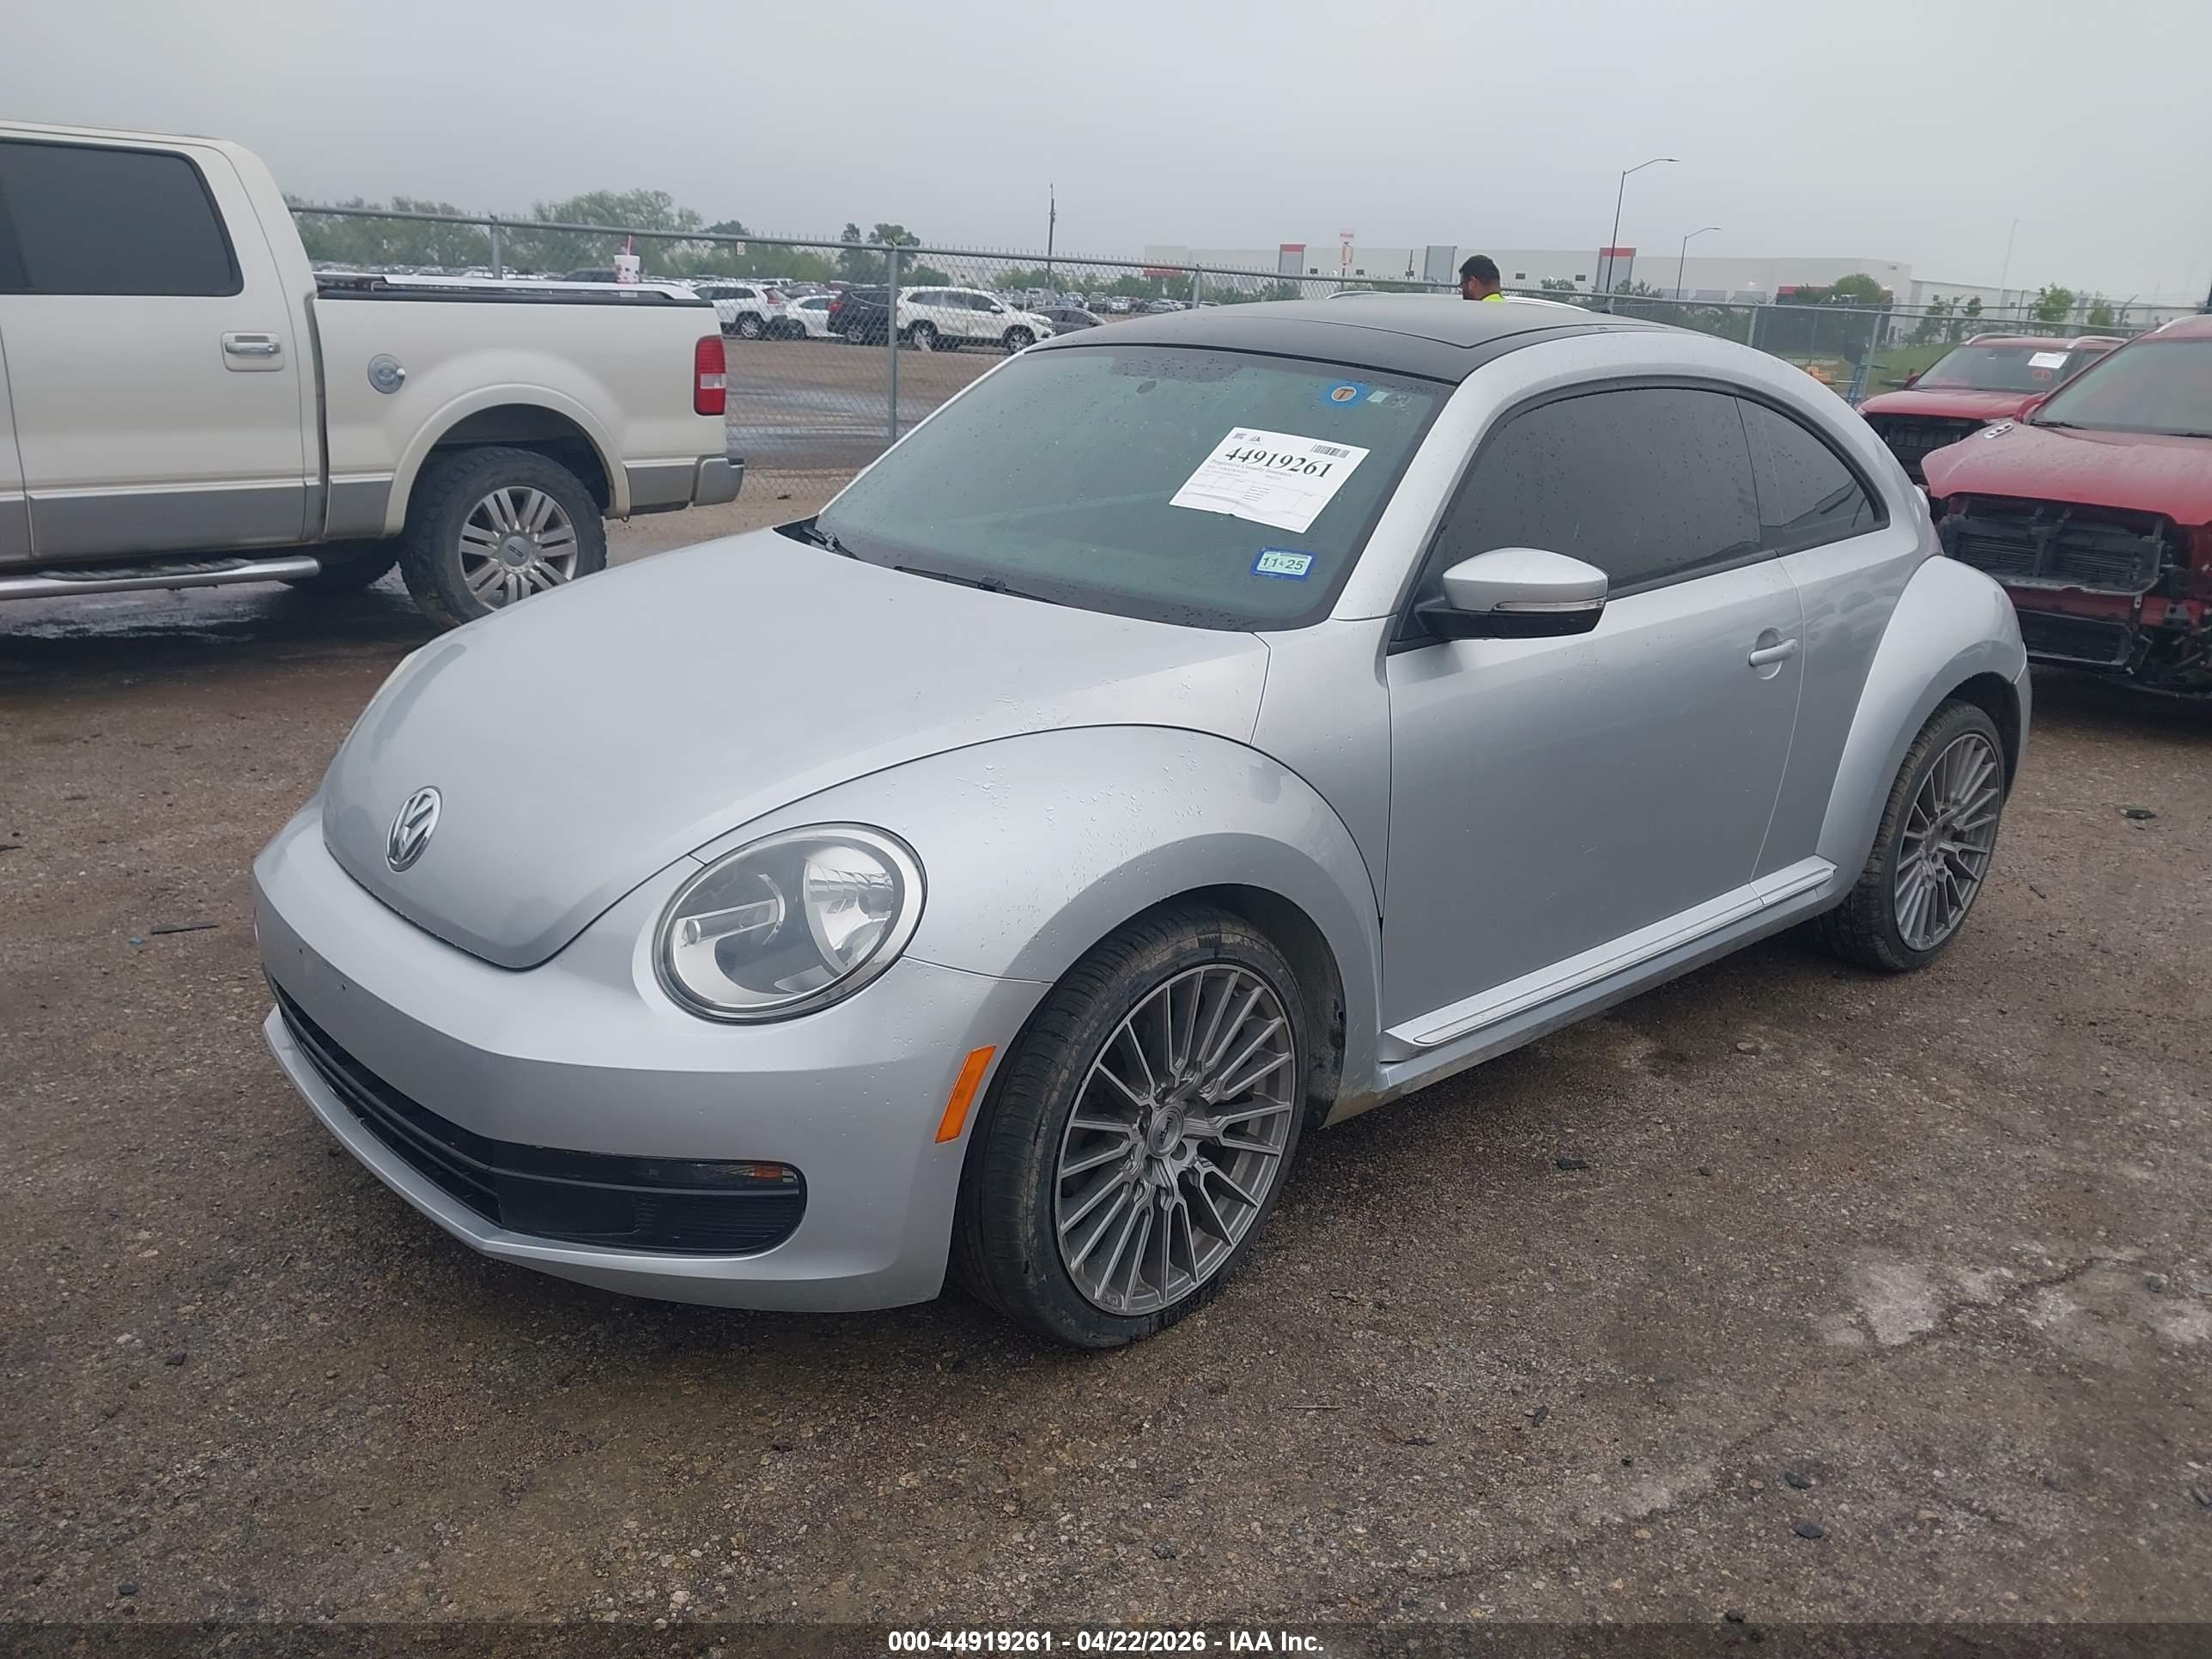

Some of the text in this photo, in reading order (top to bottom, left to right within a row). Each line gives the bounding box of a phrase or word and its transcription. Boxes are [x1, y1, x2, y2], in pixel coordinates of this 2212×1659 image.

[1225, 447, 1334, 478] 44919261
[1263, 556, 1279, 568] 11
[1285, 559, 1304, 570] 25
